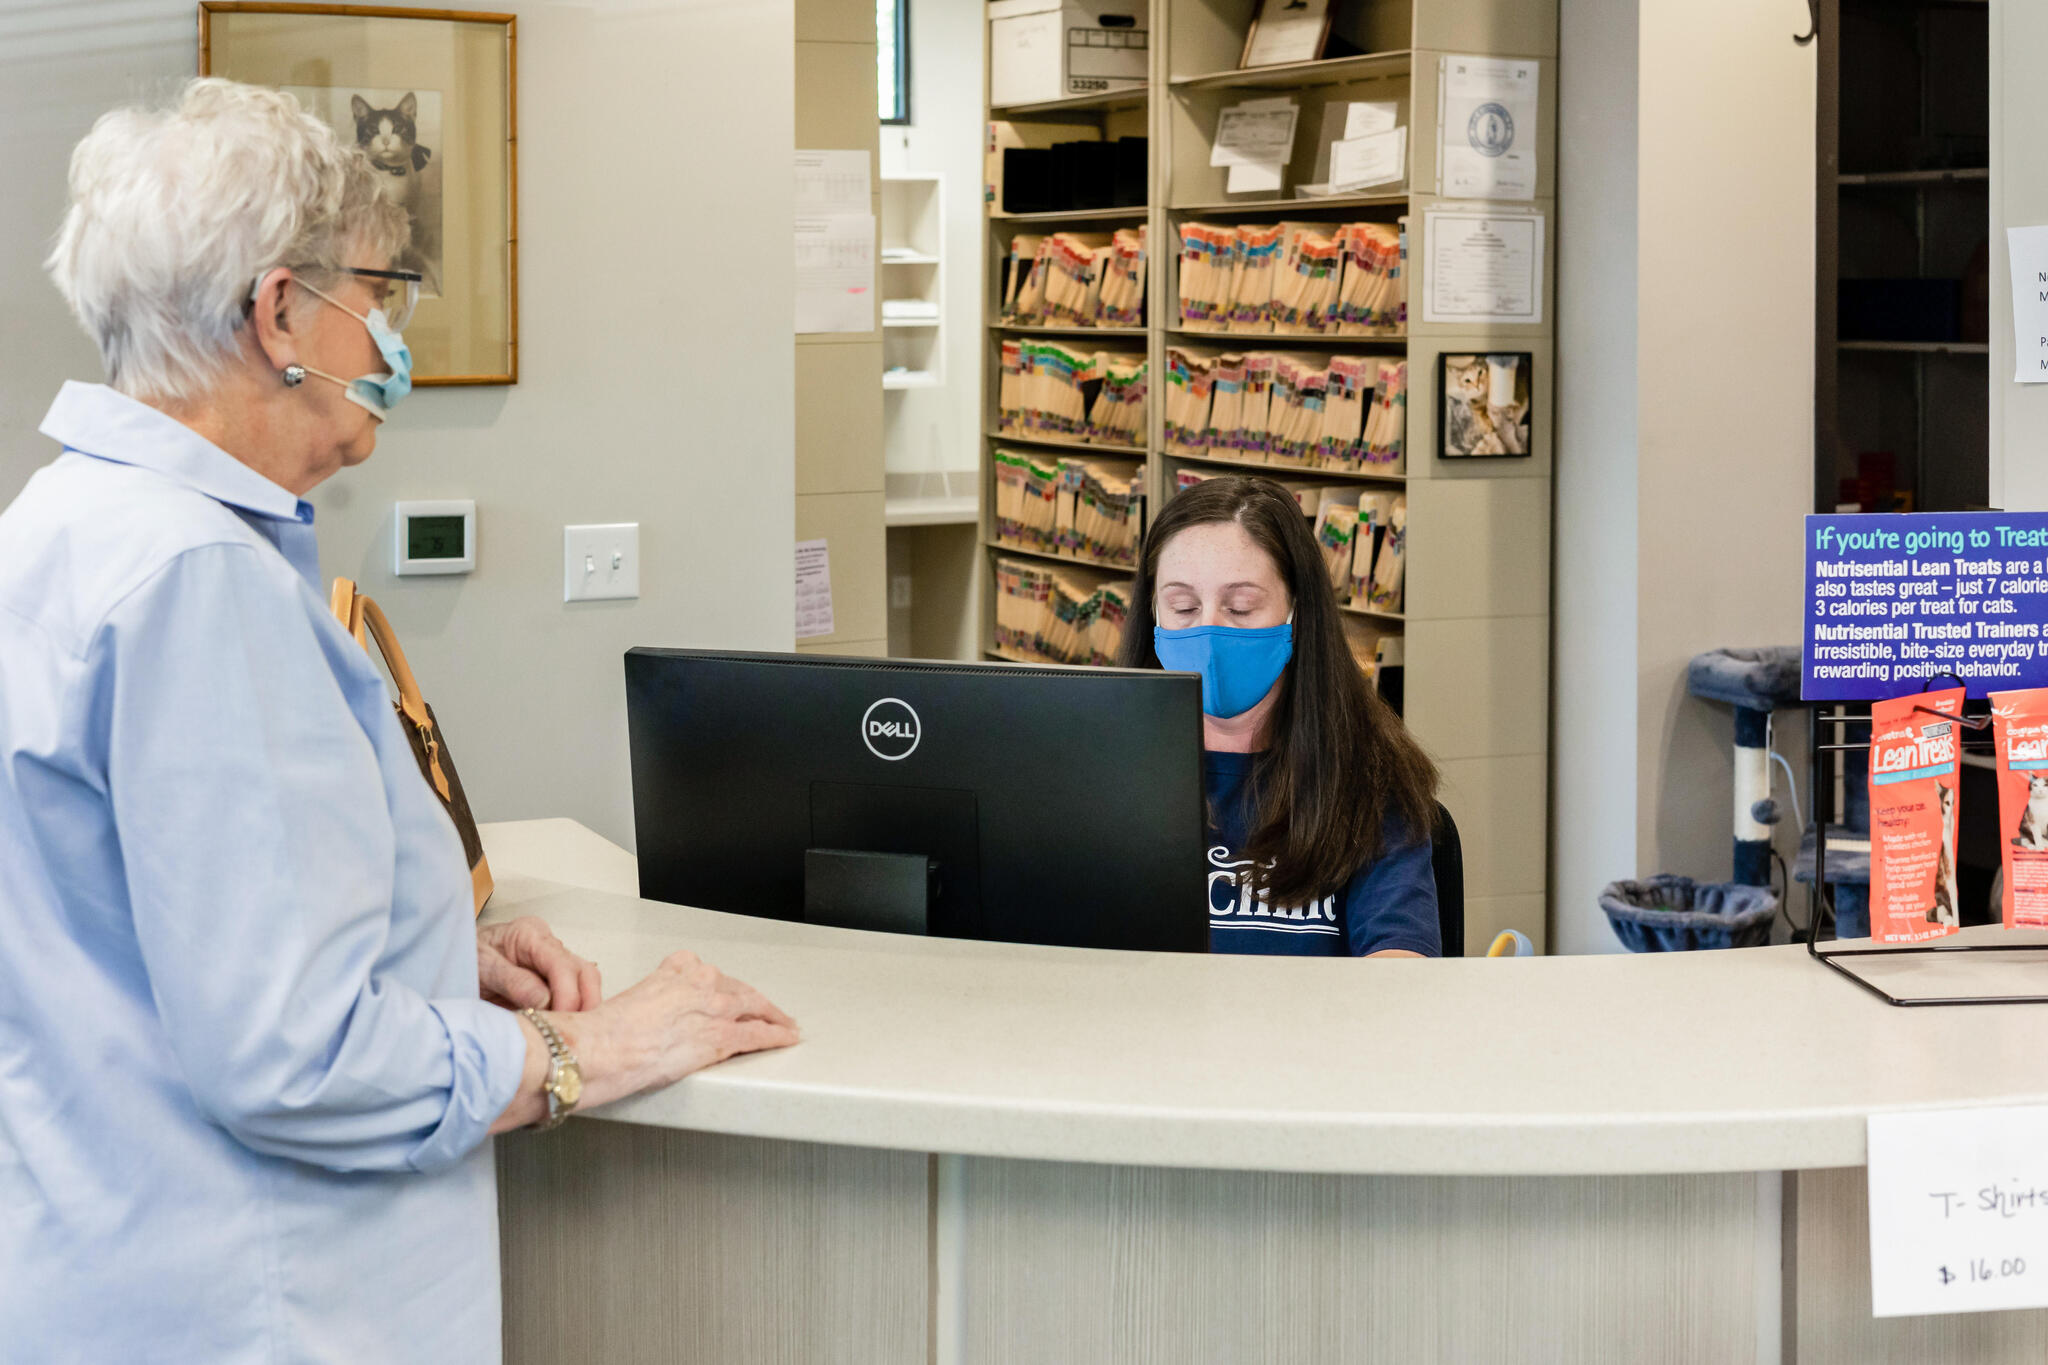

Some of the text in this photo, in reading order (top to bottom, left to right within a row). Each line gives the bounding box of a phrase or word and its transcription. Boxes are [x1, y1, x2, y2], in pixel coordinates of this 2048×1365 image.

[1816, 526, 1836, 549] If
[1836, 528, 1900, 556] you're
[1905, 525, 1964, 555] going
[1968, 529, 1991, 548] to
[1816, 560, 1908, 577] Nutrisential
[1912, 559, 1950, 576] Lean
[1953, 558, 2003, 575] Treats
[2006, 561, 2029, 575] are
[2033, 561, 2043, 574] a
[1815, 580, 1847, 596] also
[1850, 580, 1895, 596] tastes
[1899, 579, 1938, 598] great
[1955, 578, 1984, 598] just
[1986, 578, 1997, 594] 7
[1815, 597, 2018, 619] 3 calories per treat for cats.
[1814, 623, 1908, 640] Nutrisential
[1912, 622, 1972, 640] Trusted
[1975, 621, 2039, 638] Trainers
[1814, 642, 1897, 661] irresistible,
[1900, 642, 1965, 659] bite-size
[1968, 640, 2035, 661] everyday
[1813, 660, 2021, 682] rewarding positive behavior.
[870, 720, 915, 738] DELL
[1873, 745, 1918, 773] Lean
[1939, 1257, 2026, 1286] $ 16.00
